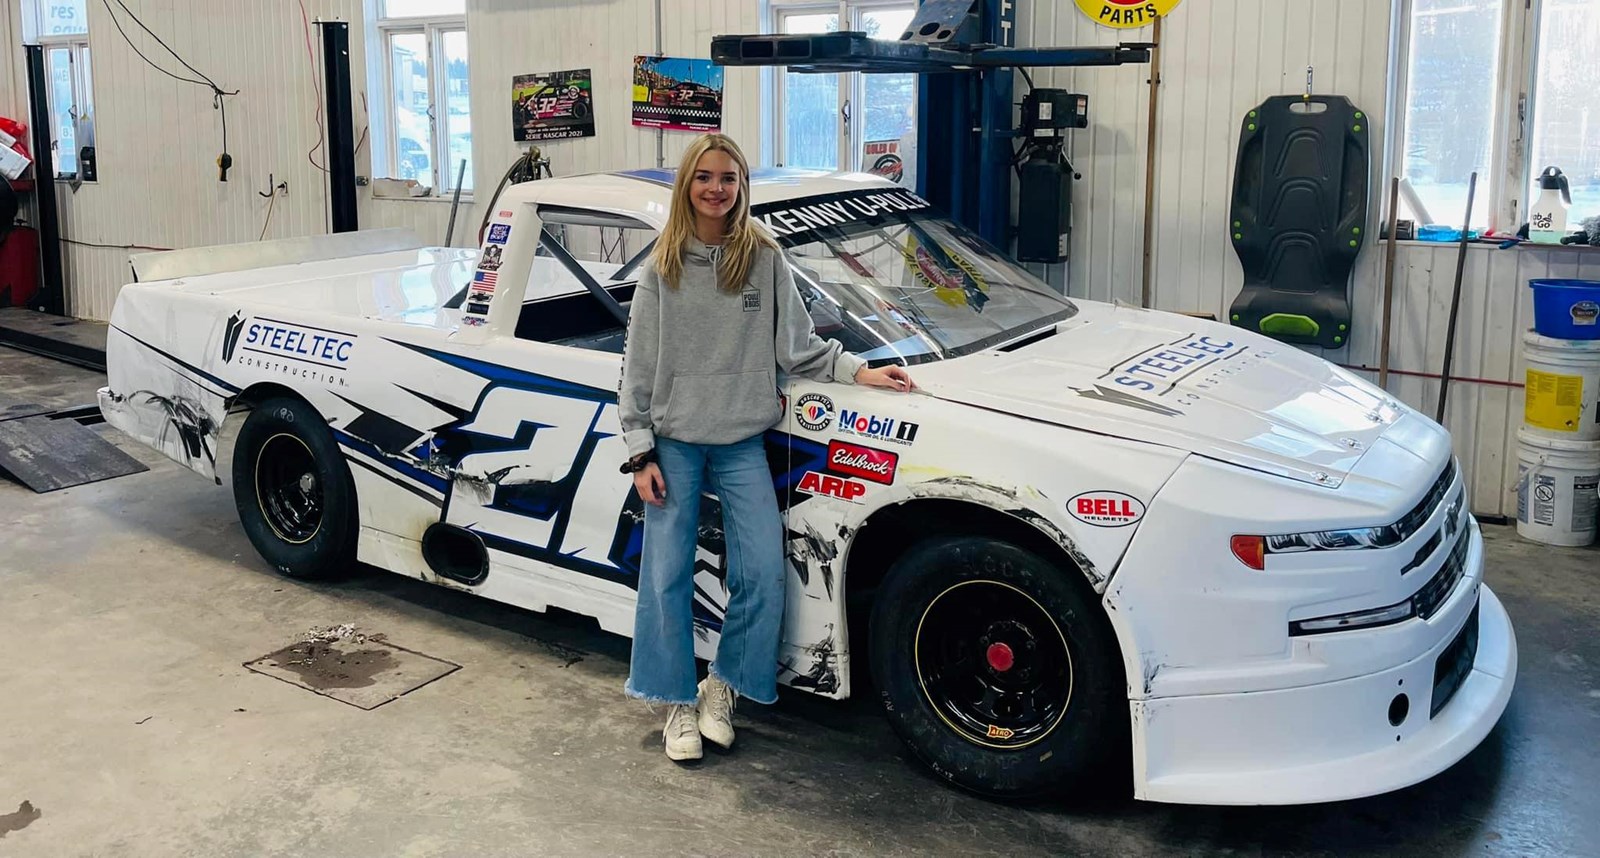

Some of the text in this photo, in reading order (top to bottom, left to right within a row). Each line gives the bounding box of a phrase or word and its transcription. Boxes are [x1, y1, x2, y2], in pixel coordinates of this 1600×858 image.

[1100, 4, 1158, 24] PARTS
[537, 98, 557, 113] 32
[677, 89, 694, 101] 32
[752, 199, 857, 238] KENNY
[851, 190, 926, 217] U-PULL
[246, 324, 353, 362] STEELTEC
[238, 356, 345, 387] CONSTRUCTION
[800, 395, 820, 404] NASCAR
[839, 409, 895, 437] Mobil
[832, 448, 890, 475] Edelbrock
[798, 472, 866, 500] ARP
[1077, 498, 1136, 517] BELL
[991, 728, 1009, 737] AERO
